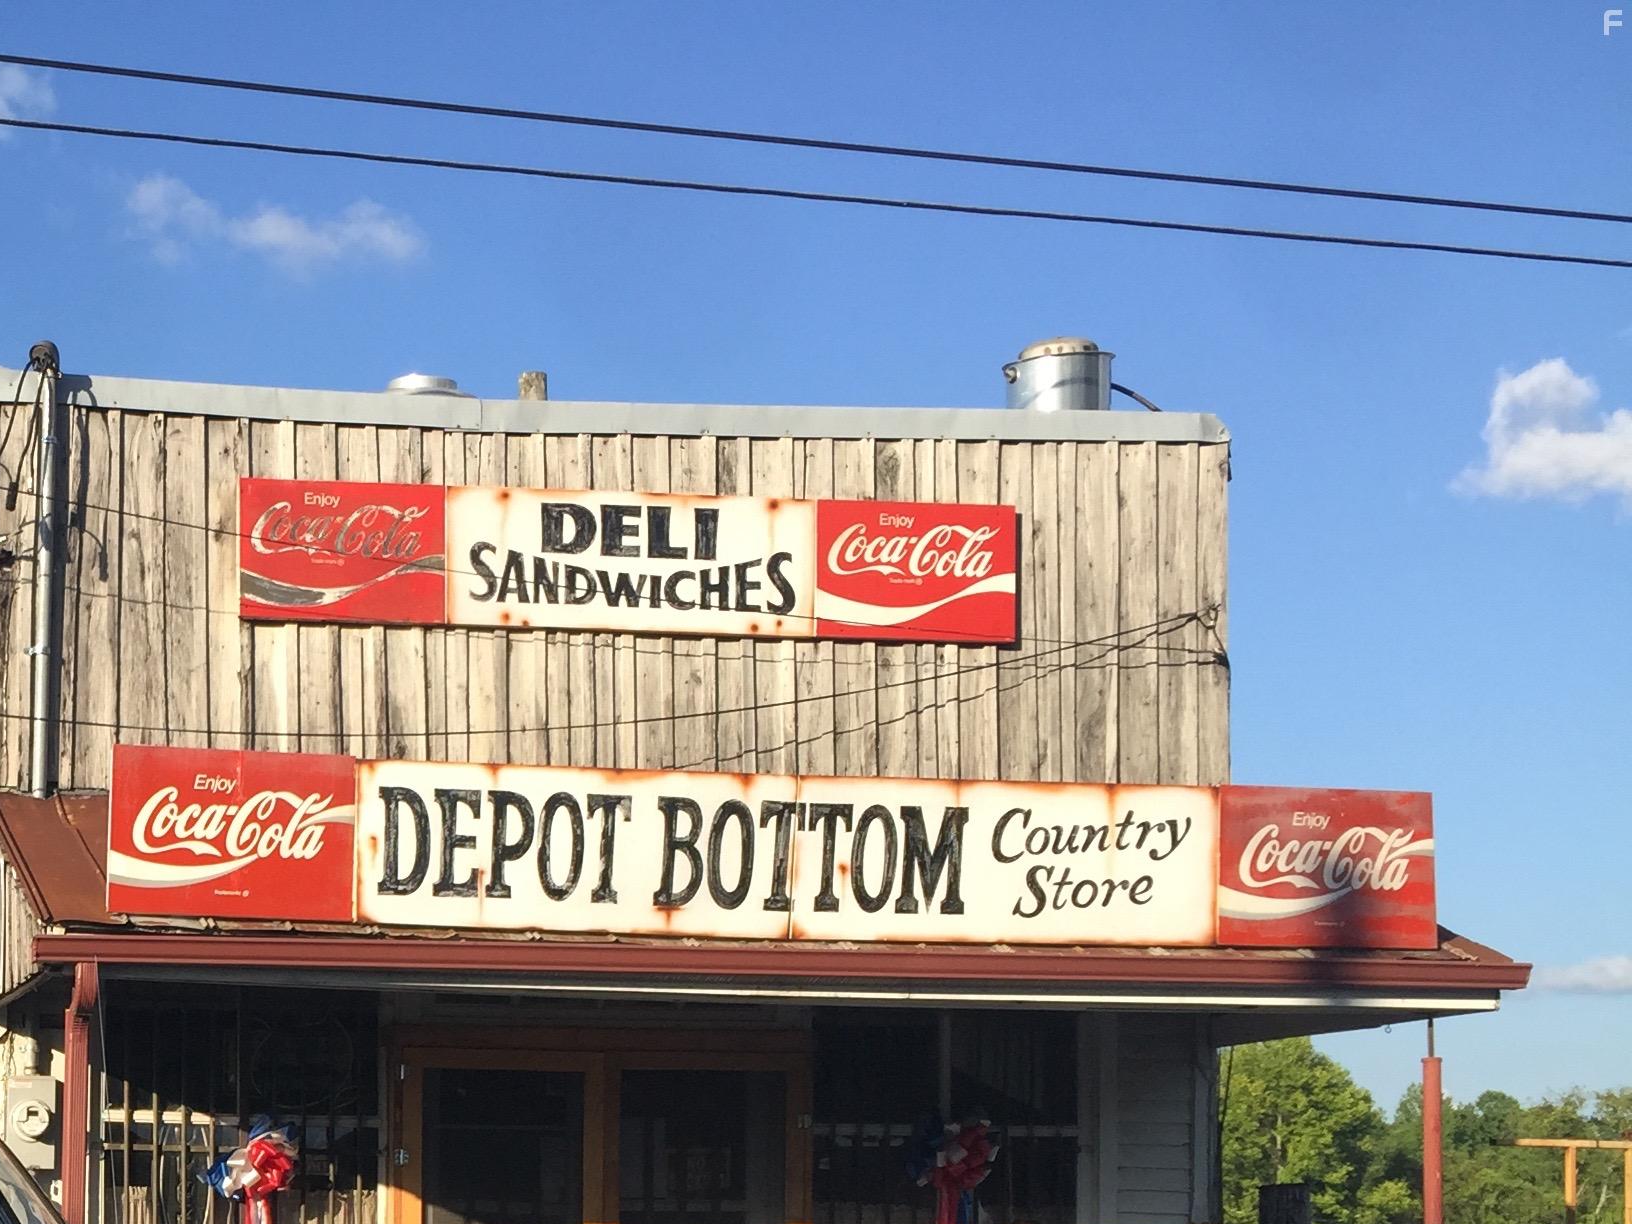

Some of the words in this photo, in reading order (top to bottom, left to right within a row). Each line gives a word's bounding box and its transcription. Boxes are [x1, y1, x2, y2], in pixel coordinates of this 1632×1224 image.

[303, 491, 341, 508] Enjoy
[879, 512, 916, 529] Enjoy
[250, 501, 430, 558] Coca-Cola
[540, 502, 720, 561] DELI
[827, 523, 1001, 578] Coca-Cola
[468, 541, 797, 616] SANDWICHES
[192, 773, 237, 794] Enjoy
[132, 785, 334, 861] Coca-Cola
[991, 807, 1192, 864] Country
[1292, 811, 1331, 830] Enjoy
[377, 785, 633, 905] DEPOT
[652, 795, 969, 915] BOTTOM
[1238, 823, 1415, 892] Coca-Cola
[1012, 864, 1154, 919] Store
